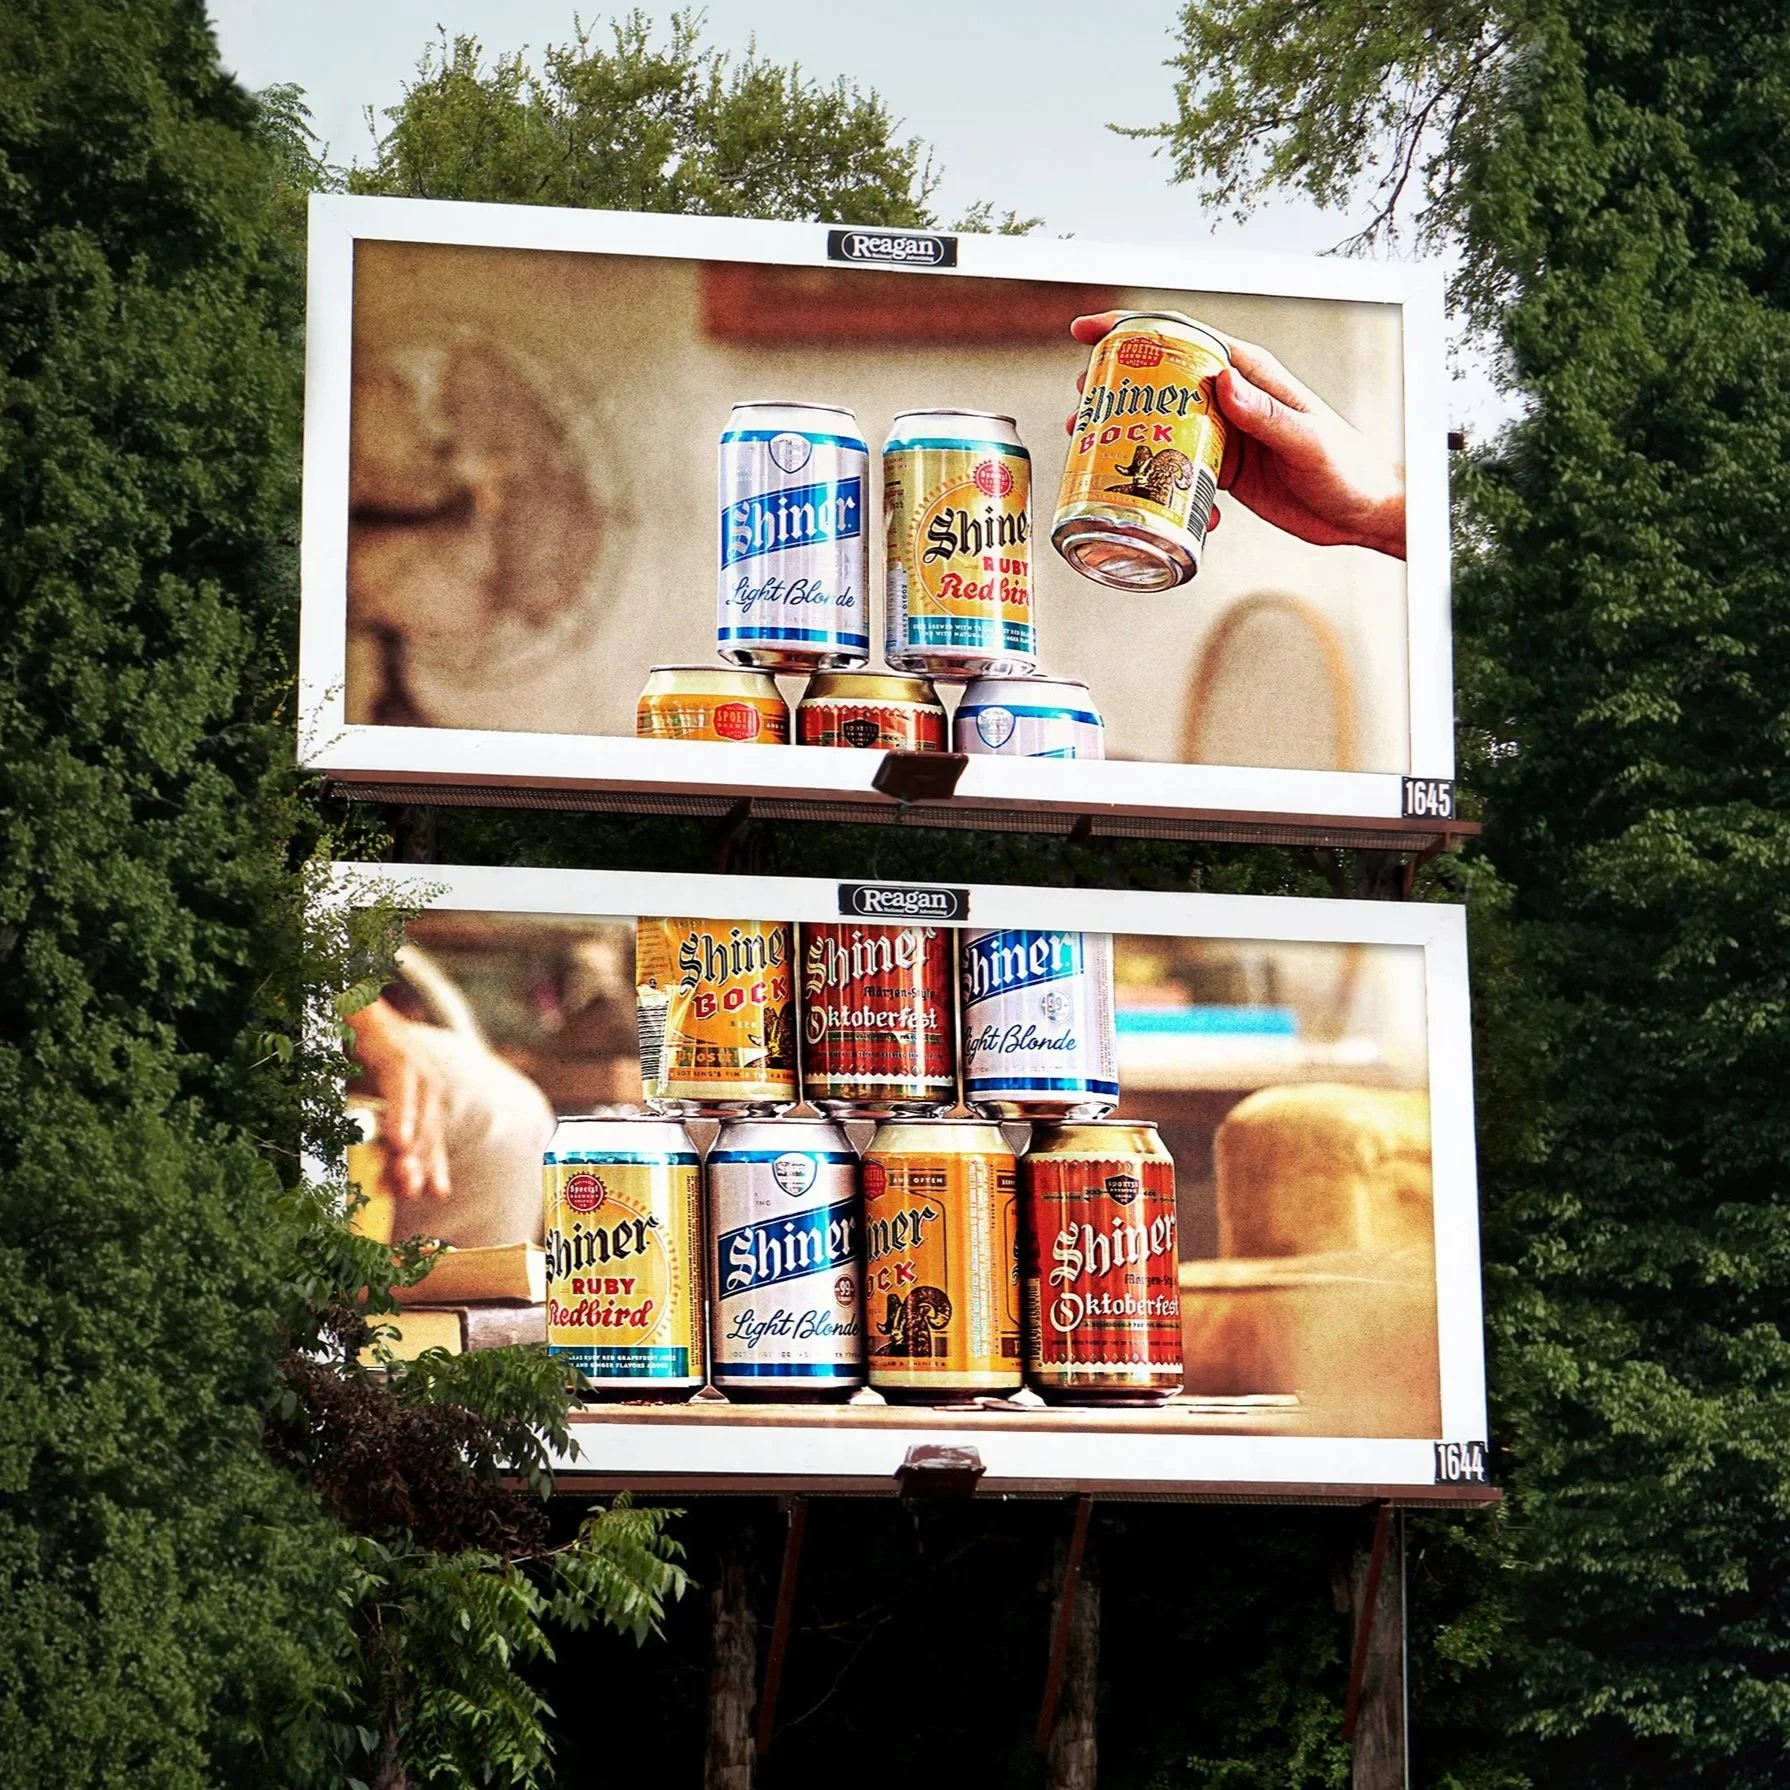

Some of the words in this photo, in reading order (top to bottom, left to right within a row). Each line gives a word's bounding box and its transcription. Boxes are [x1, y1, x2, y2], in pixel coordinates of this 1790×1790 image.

[852, 235, 935, 260] Reagan
[1077, 378, 1203, 432] Shiner
[1079, 423, 1174, 455] BOCK
[727, 493, 856, 562] Shiner
[922, 506, 1032, 565] Shine
[983, 556, 1029, 578] RUBY
[725, 576, 787, 613] Light
[783, 578, 855, 608] Blonde
[1405, 781, 1451, 817] 1645
[863, 889, 948, 913] Reagan
[806, 926, 936, 999] Shiner
[692, 975, 788, 1019] BOCK
[806, 1005, 938, 1044] Oktoberfest
[999, 1024, 1077, 1053] Blonde
[726, 1216, 856, 1289] Shiner
[1049, 1213, 1176, 1286] Shiner
[572, 1278, 636, 1294] RUBY
[549, 1299, 654, 1328] Redbird
[726, 1309, 795, 1349] Light
[792, 1309, 860, 1340] Blonde
[1437, 1443, 1485, 1481] 1644
